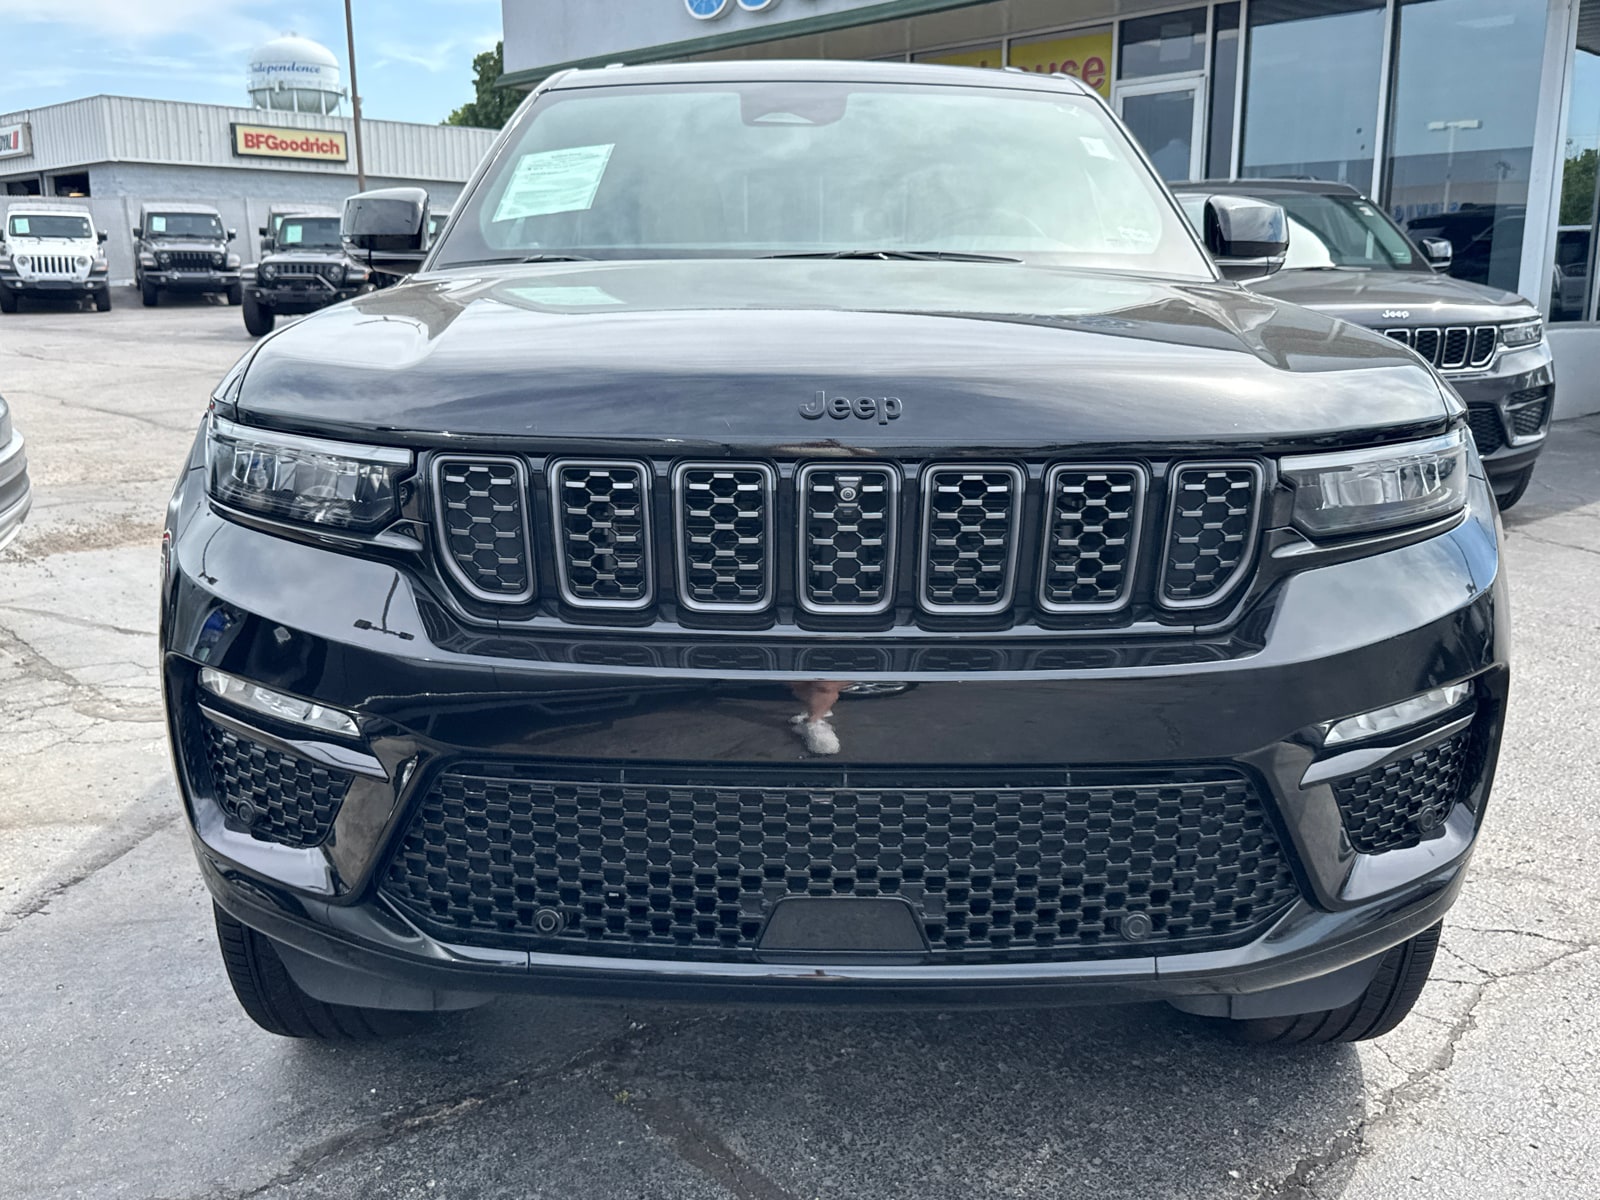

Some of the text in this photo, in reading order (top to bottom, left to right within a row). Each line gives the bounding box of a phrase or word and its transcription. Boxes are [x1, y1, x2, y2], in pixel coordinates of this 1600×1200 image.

[243, 132, 341, 155] BFGoodrich
[1382, 309, 1410, 319] Jeep
[799, 390, 903, 426] Jeep
